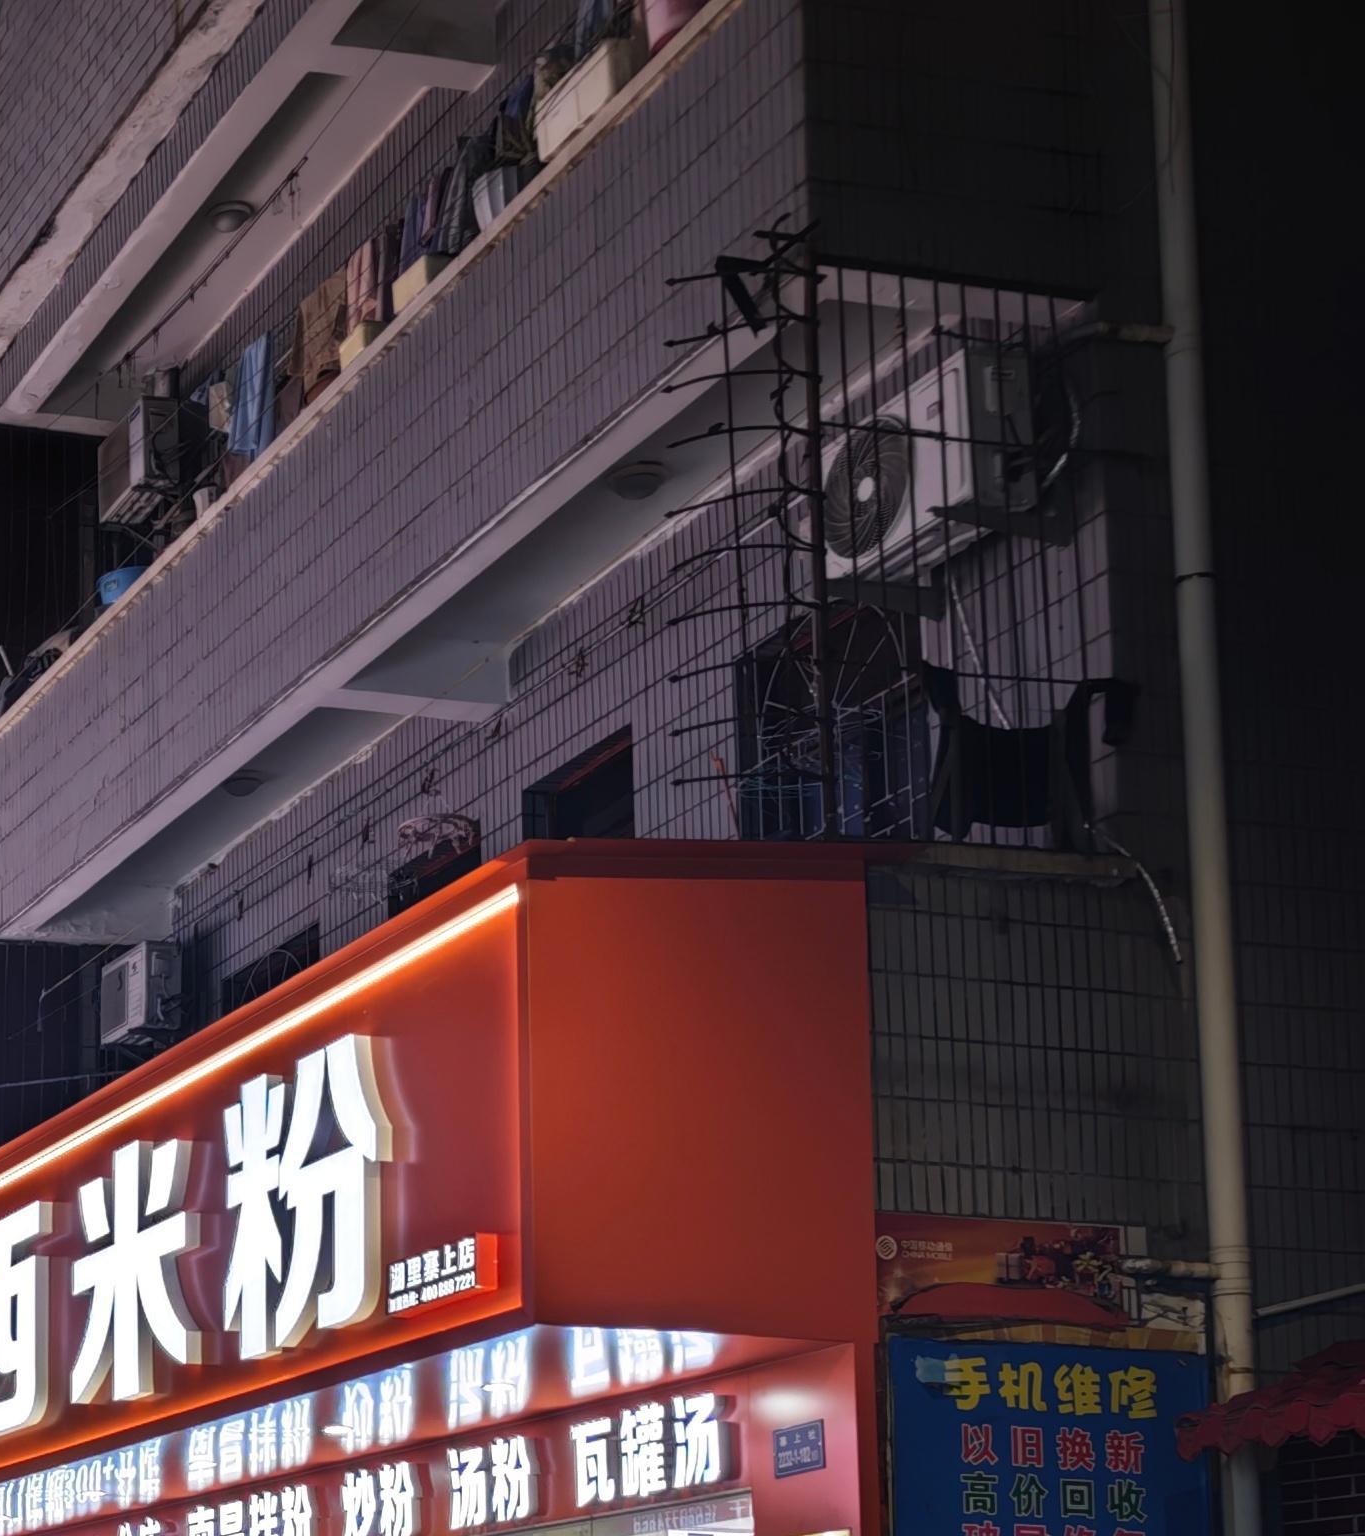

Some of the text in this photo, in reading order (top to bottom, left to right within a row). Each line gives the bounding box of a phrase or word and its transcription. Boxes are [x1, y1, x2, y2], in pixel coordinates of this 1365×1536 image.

[943, 1356, 1158, 1420] 手机维修
[447, 1434, 532, 1530] 汤粉
[570, 1392, 722, 1508] 瓦罐汤
[961, 1423, 1145, 1474] 以旧换新
[960, 1472, 1148, 1522] 高价回收
